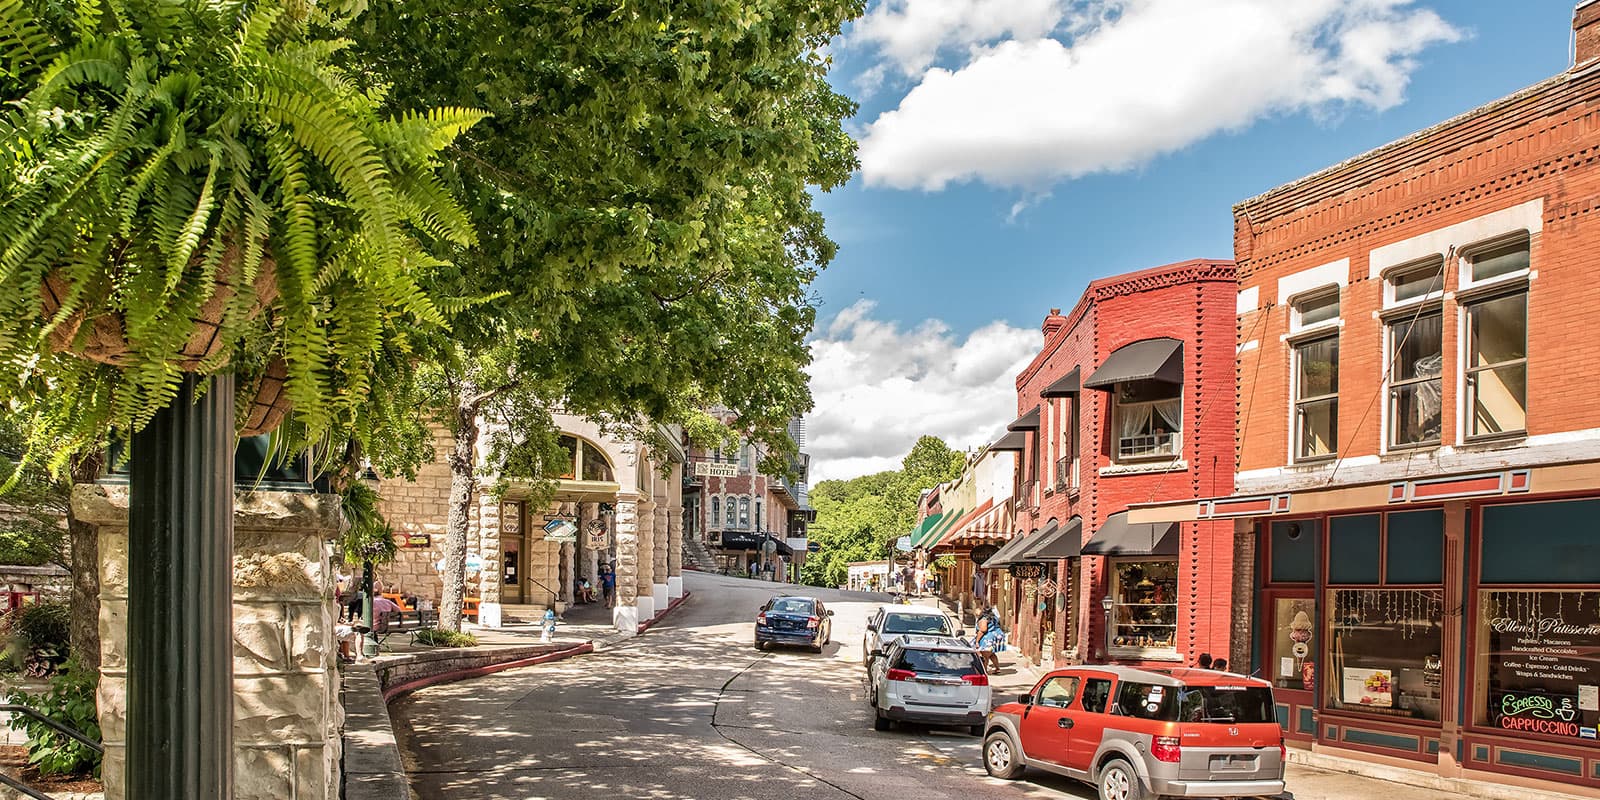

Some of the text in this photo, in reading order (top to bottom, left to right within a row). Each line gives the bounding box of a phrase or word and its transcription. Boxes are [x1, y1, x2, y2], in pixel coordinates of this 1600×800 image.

[710, 468, 736, 476] HOTEL
[1492, 617, 1535, 633] Ellen's
[1543, 638, 1571, 646] Macarons
[1512, 645, 1578, 655] Handcrafted Chocolates
[1525, 662, 1549, 670] Espresso
[1568, 665, 1587, 673] Drinks
[1539, 672, 1573, 680] Sandwiches
[1502, 716, 1578, 736] CAPPUCCINO
